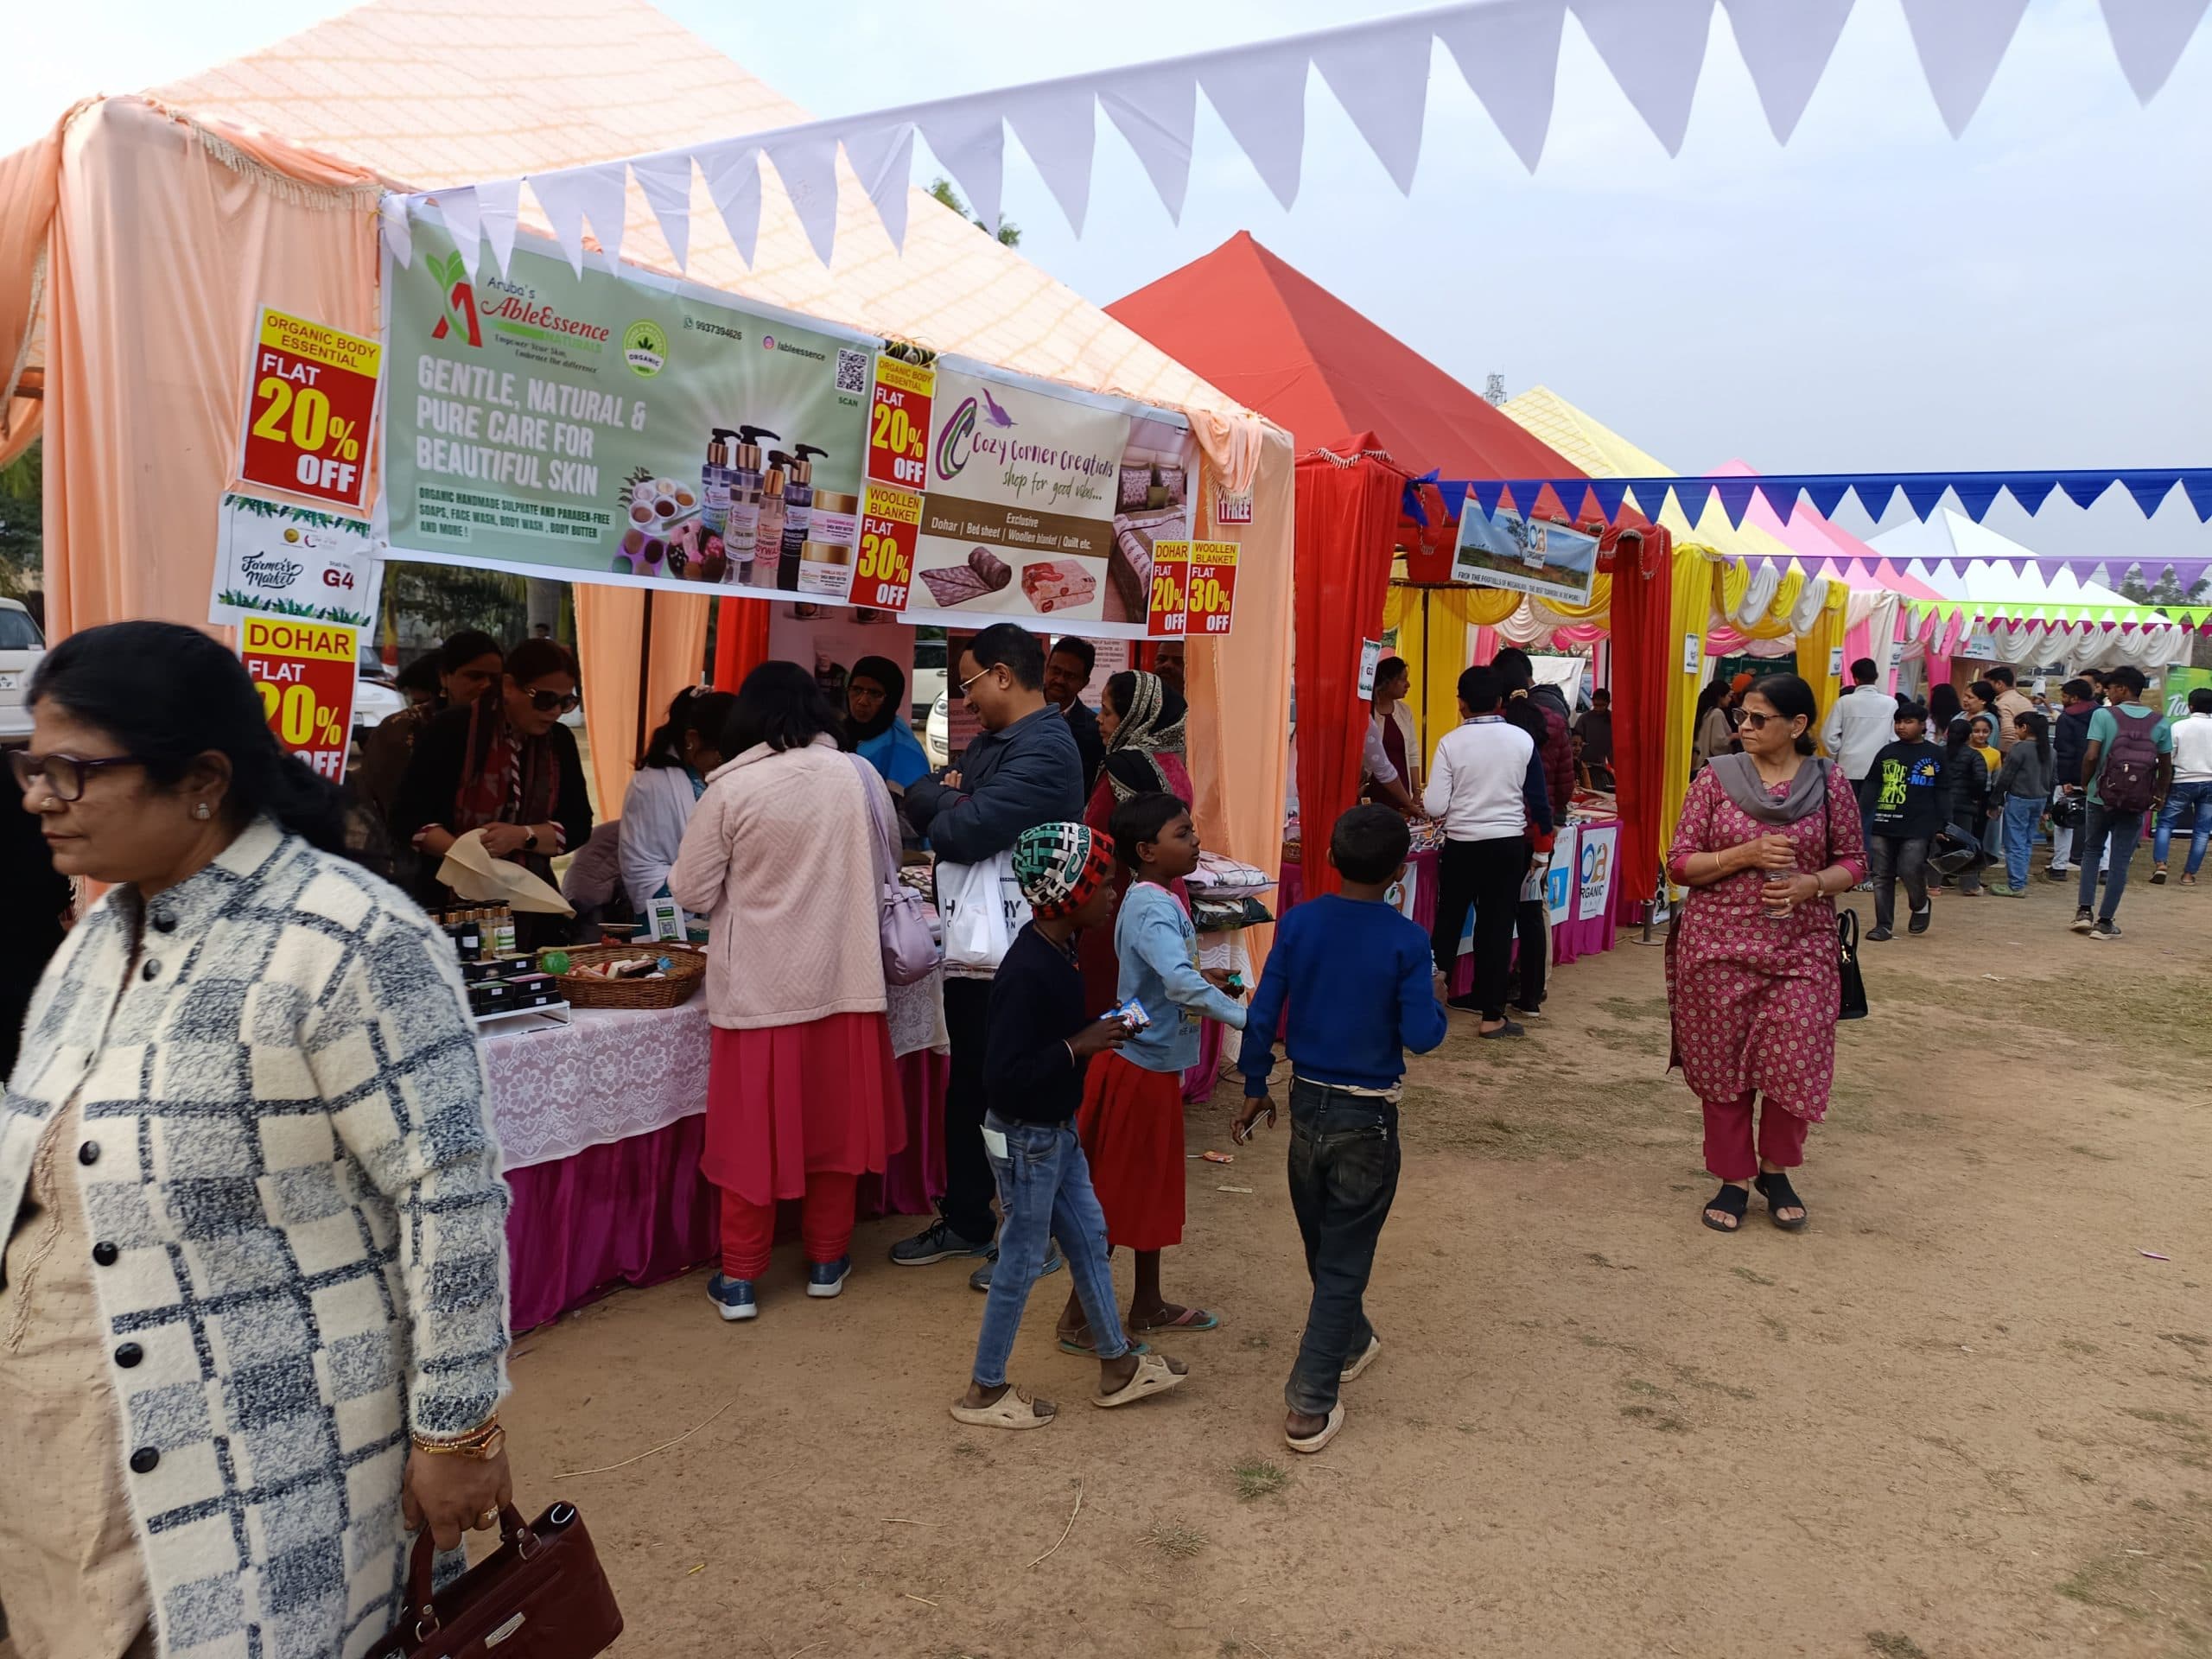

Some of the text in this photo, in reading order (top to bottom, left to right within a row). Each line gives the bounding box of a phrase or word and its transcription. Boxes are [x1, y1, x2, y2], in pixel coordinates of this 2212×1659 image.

[487, 277, 536, 299] Aruba's
[480, 297, 609, 342] AbleEssence
[267, 315, 377, 358] ORGANIC BODY
[281, 335, 359, 367] ESSENTIAL
[628, 353, 660, 367] ORGANIC
[263, 353, 321, 385] FLAT
[879, 360, 933, 383] ORGANIC BODY
[418, 354, 646, 431] GENTLE, NATURAL &
[885, 373, 922, 391] ESSENTIAL
[838, 397, 858, 407] SCAN
[875, 387, 905, 407] FLAT
[252, 377, 359, 461] 20%
[416, 396, 594, 459] PURE CARE FOR
[872, 403, 924, 458] 20%
[416, 435, 598, 497] BEAUTIFUL SKIN
[972, 432, 1114, 478] Cozy Corner Creations
[296, 454, 356, 493] OFF
[893, 457, 925, 482] OFF
[1002, 463, 1027, 499] shop
[1031, 472, 1048, 496] for
[1048, 477, 1074, 505] good
[419, 487, 611, 525] ORGANIC HANDMADE SULPHATE AND PARABEN-FREE
[870, 488, 919, 509] WOOLLEN
[419, 504, 449, 519] SOAPS,
[451, 508, 471, 522] FACE
[473, 512, 499, 526] WASH,
[500, 516, 519, 529] BODY
[550, 522, 569, 535] BODY
[571, 525, 598, 538] BUTTER
[870, 503, 917, 521] BLANKET
[1006, 512, 1039, 528] Exclusive
[420, 520, 436, 533] AND
[439, 523, 463, 537] MORE
[864, 518, 893, 536] FLAT
[931, 517, 957, 532] Dohar
[966, 522, 980, 535] Bed
[981, 525, 1001, 538] sheet
[1008, 529, 1036, 543] Woollen
[1063, 536, 1078, 548] Quilt
[858, 534, 909, 583] 30%
[1156, 545, 1188, 558] DOHAR
[1195, 543, 1236, 554] WOOLLEN
[1196, 554, 1234, 564] BLANKET
[242, 550, 295, 573] Farmer's
[1154, 565, 1172, 577] FLAT
[1192, 566, 1215, 578] FLAT
[245, 564, 303, 589] Market
[323, 569, 354, 590] G4
[1458, 571, 1470, 580] FROM
[1471, 573, 1480, 582] THE
[876, 583, 906, 606] OFF
[1151, 577, 1184, 612] 20%
[1189, 578, 1230, 613] 30%
[1164, 613, 1184, 630] OFF
[1206, 615, 1230, 631] OFF
[250, 624, 349, 655] DOHAR
[248, 659, 305, 682] FLAT
[1580, 885, 1604, 899] RGANIC
